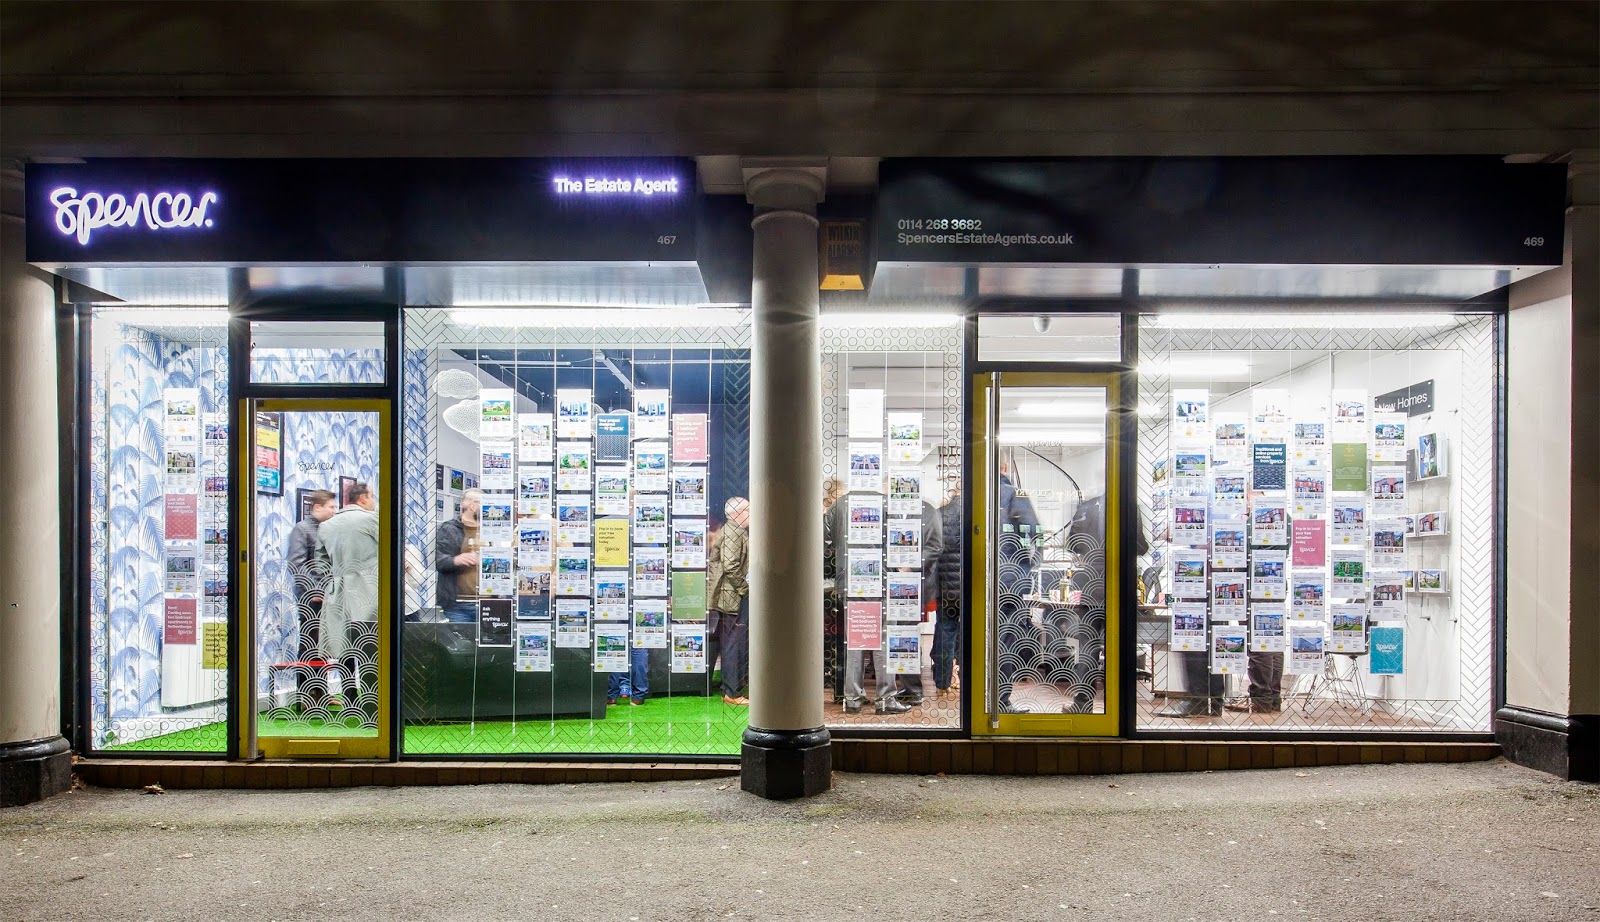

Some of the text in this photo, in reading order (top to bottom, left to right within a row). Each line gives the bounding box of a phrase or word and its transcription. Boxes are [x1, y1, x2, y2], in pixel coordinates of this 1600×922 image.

[555, 178, 678, 195] The Estate Agent
[897, 219, 982, 230] 0114 268 3682
[657, 235, 677, 245] 467
[897, 232, 1073, 246] SpencersEstateAgents.co.uk
[1523, 236, 1545, 246] 469
[1397, 393, 1428, 410] Homes
